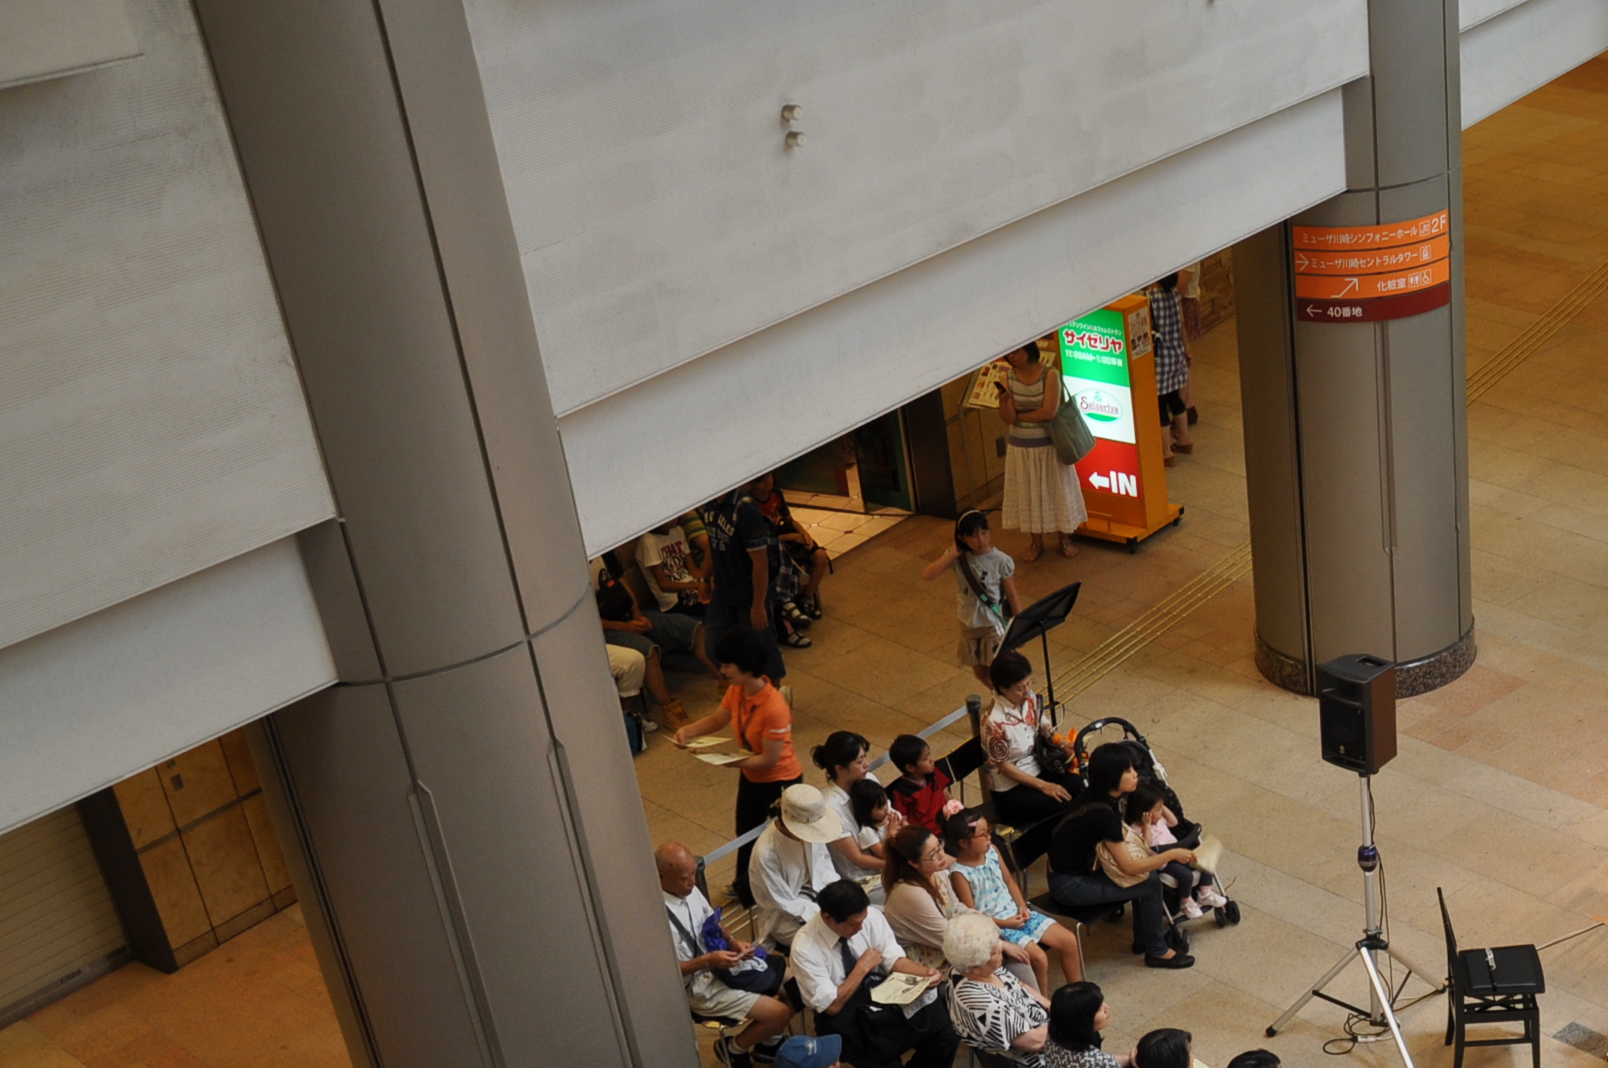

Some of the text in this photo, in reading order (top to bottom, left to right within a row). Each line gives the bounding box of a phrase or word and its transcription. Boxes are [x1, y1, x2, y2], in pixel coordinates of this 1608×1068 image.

[1302, 213, 1447, 244] ミューザ川崎シンフォニーホール 2F
[1311, 252, 1418, 269] ミューザ川崎セントラルタワー
[1326, 306, 1363, 318] 40番地
[1063, 329, 1124, 354] サイゼリヤ
[1109, 471, 1138, 498] IN
